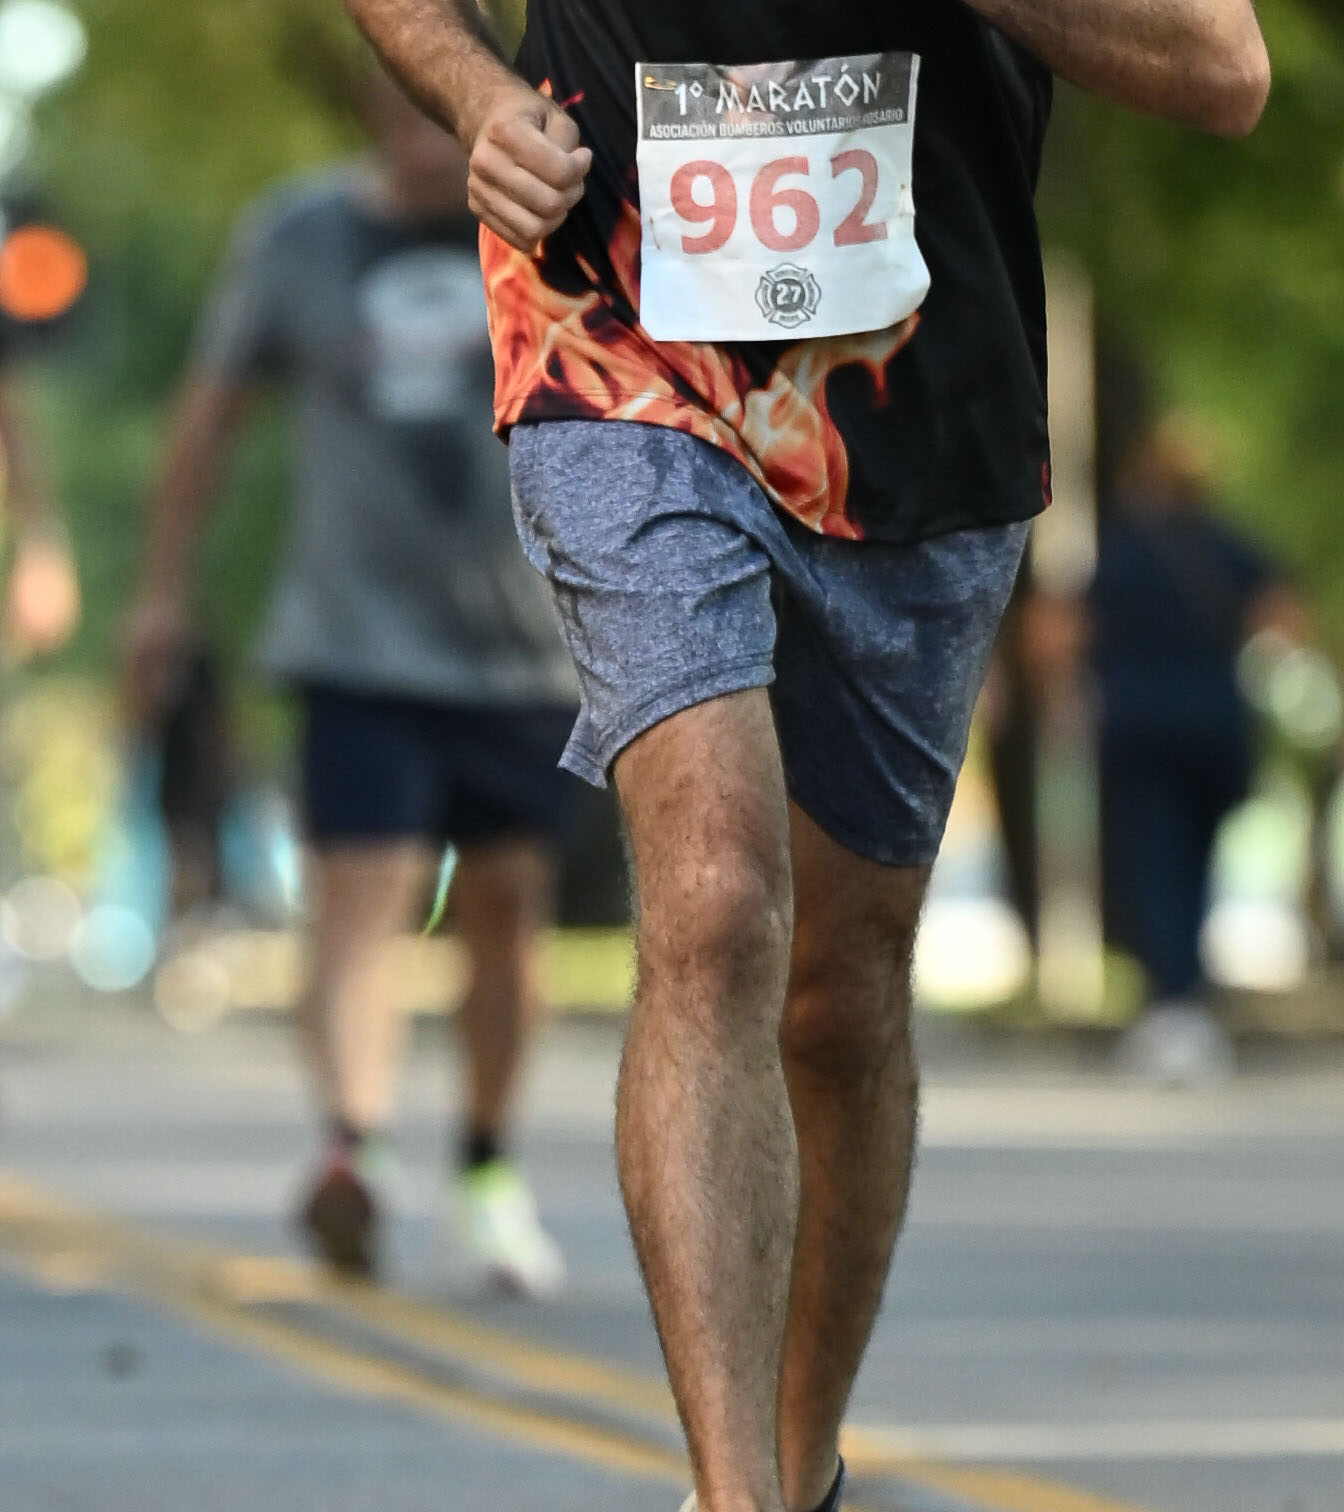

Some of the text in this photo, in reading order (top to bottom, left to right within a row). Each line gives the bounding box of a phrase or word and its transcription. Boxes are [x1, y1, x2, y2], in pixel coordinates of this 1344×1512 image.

[715, 63, 882, 115] MARATÓN
[649, 119, 716, 138] ASOCIACIÓN
[718, 120, 785, 138] BOMBEROS
[668, 147, 890, 256] 962
[775, 283, 802, 306] 27
